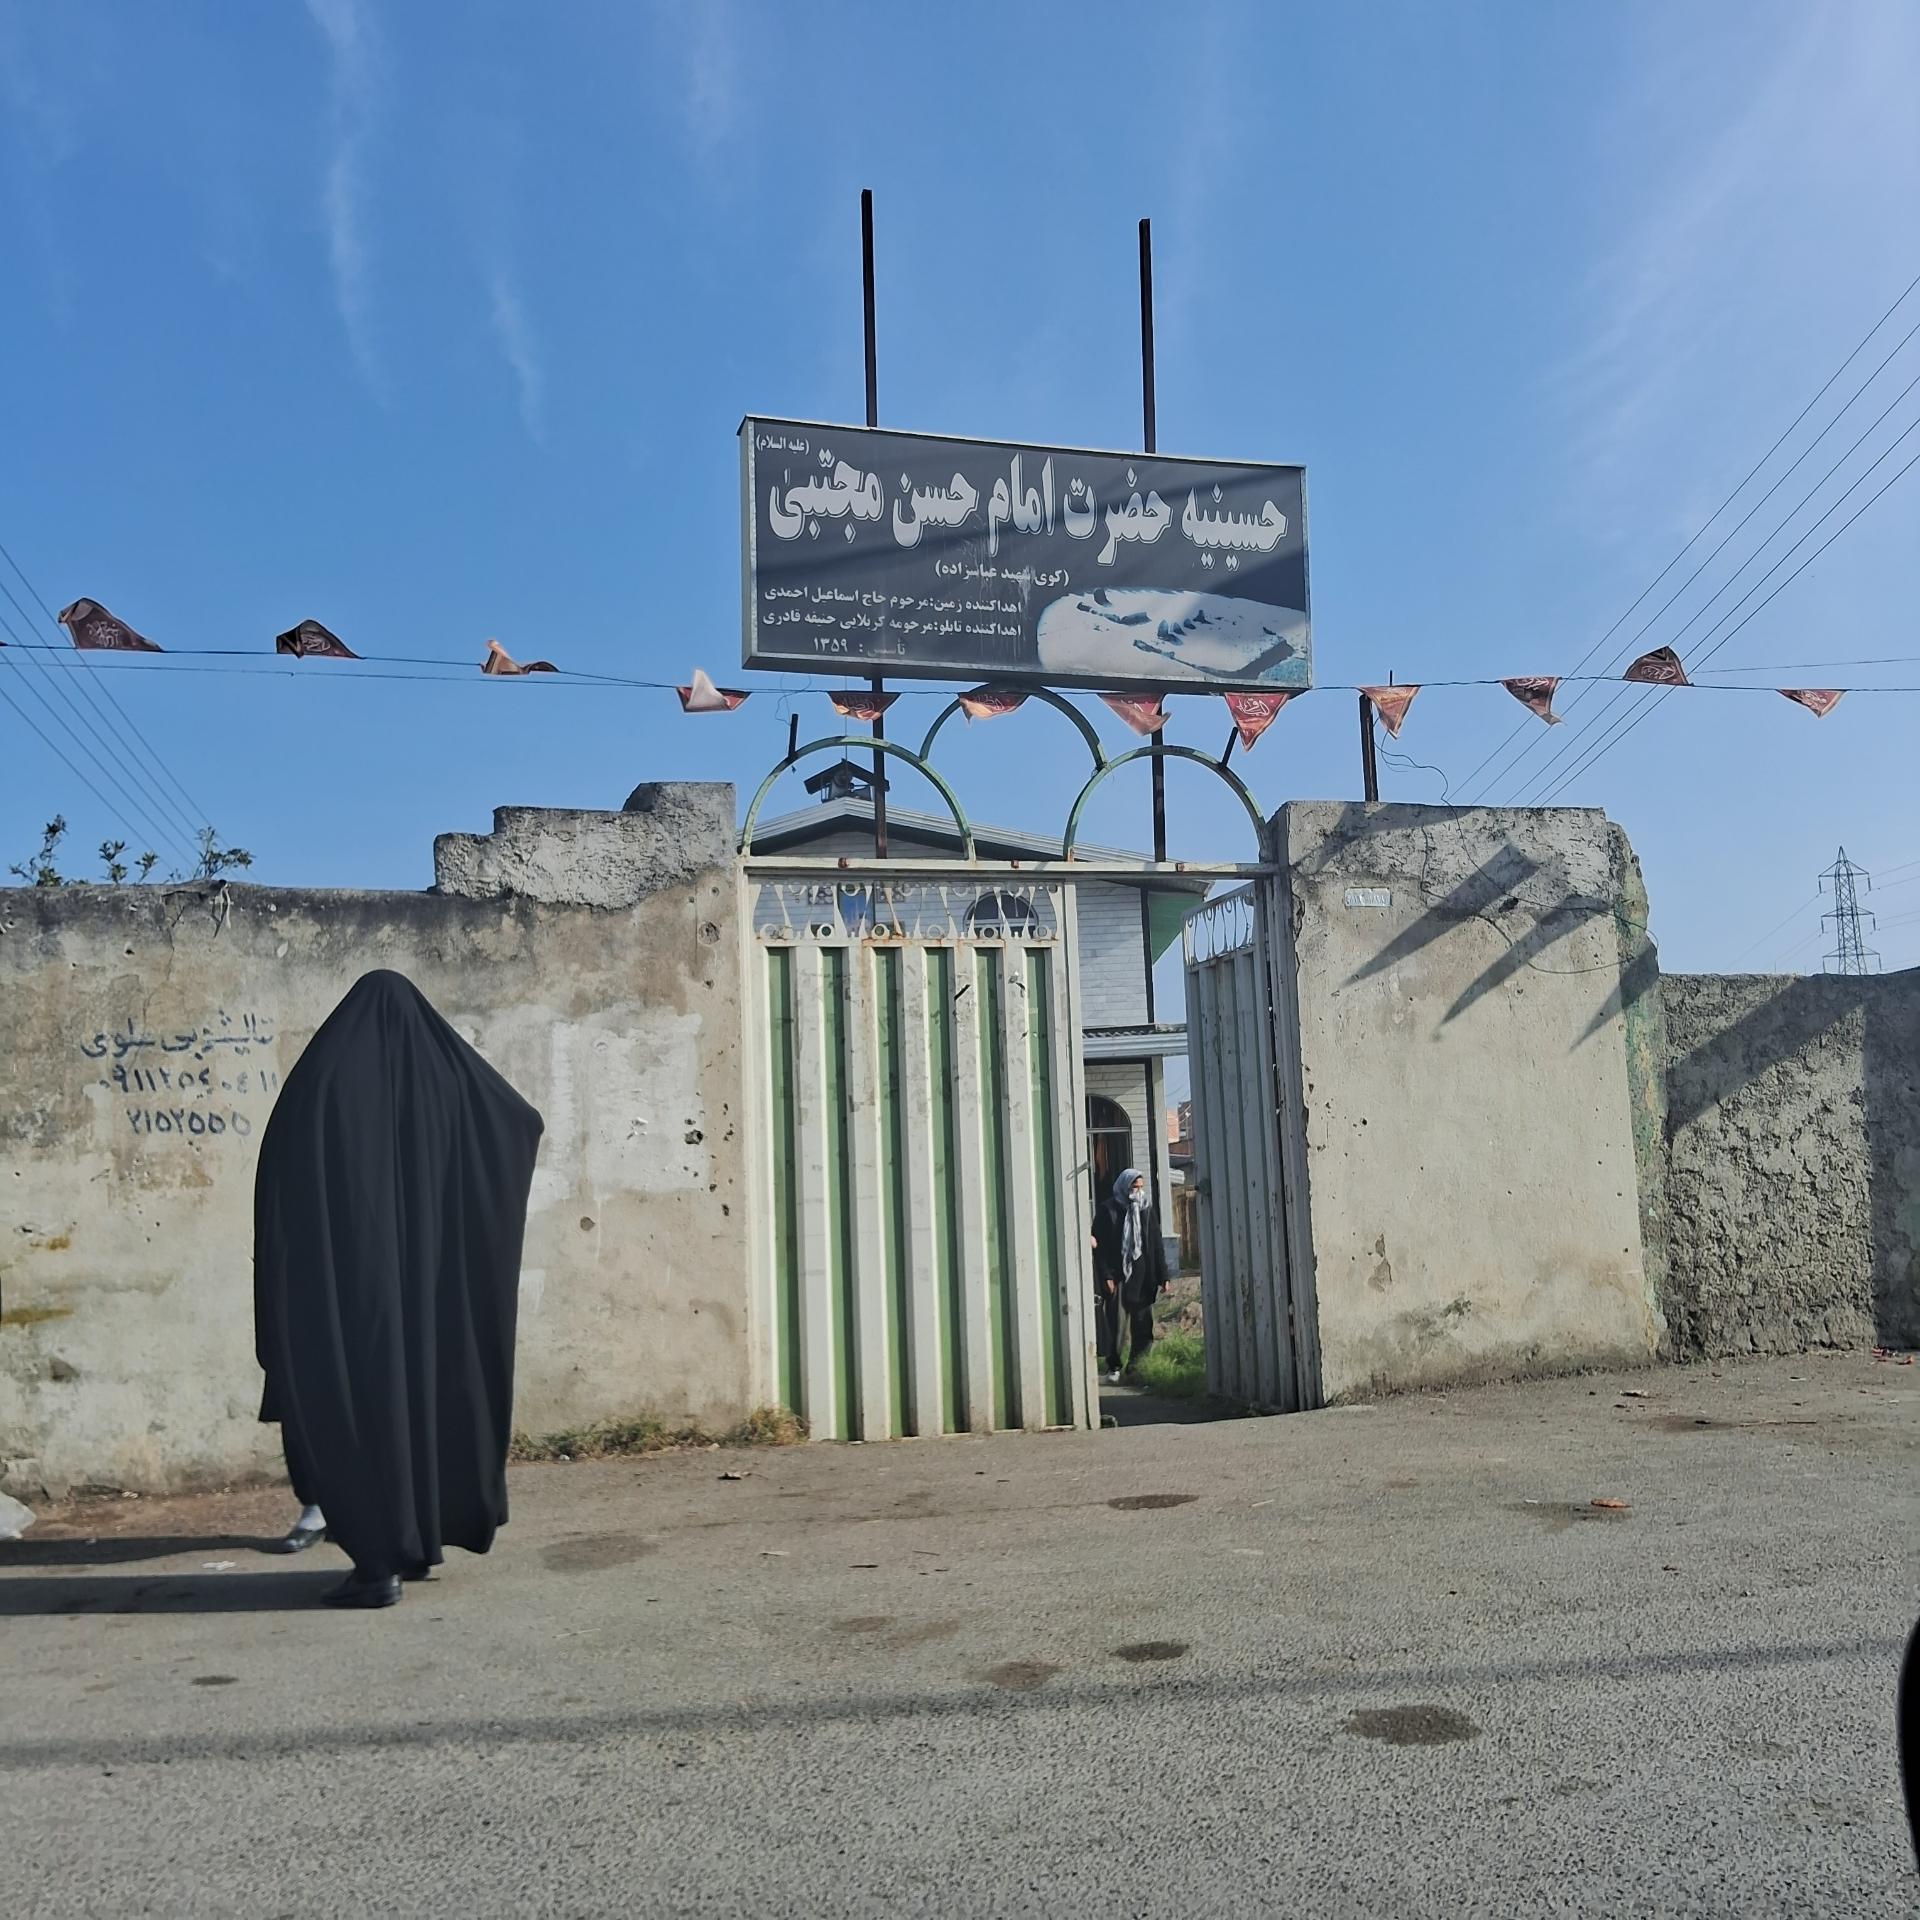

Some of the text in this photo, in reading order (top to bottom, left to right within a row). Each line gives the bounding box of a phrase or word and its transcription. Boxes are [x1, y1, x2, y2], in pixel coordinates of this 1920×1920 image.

[892, 472, 979, 549] حسن
[988, 452, 1055, 558] امام
[1063, 466, 1173, 566] حضرت
[1181, 483, 1288, 572] حسینیه
[764, 585, 809, 600] احمدی
[811, 586, 859, 603] اسماعیل
[861, 590, 887, 607] حاج
[965, 598, 1022, 614] اهداکننده
[762, 607, 802, 627] قادری
[804, 609, 837, 627] حنیفه
[965, 622, 1022, 637] اهداکننده
[812, 637, 849, 653] ۱۳۵۹
